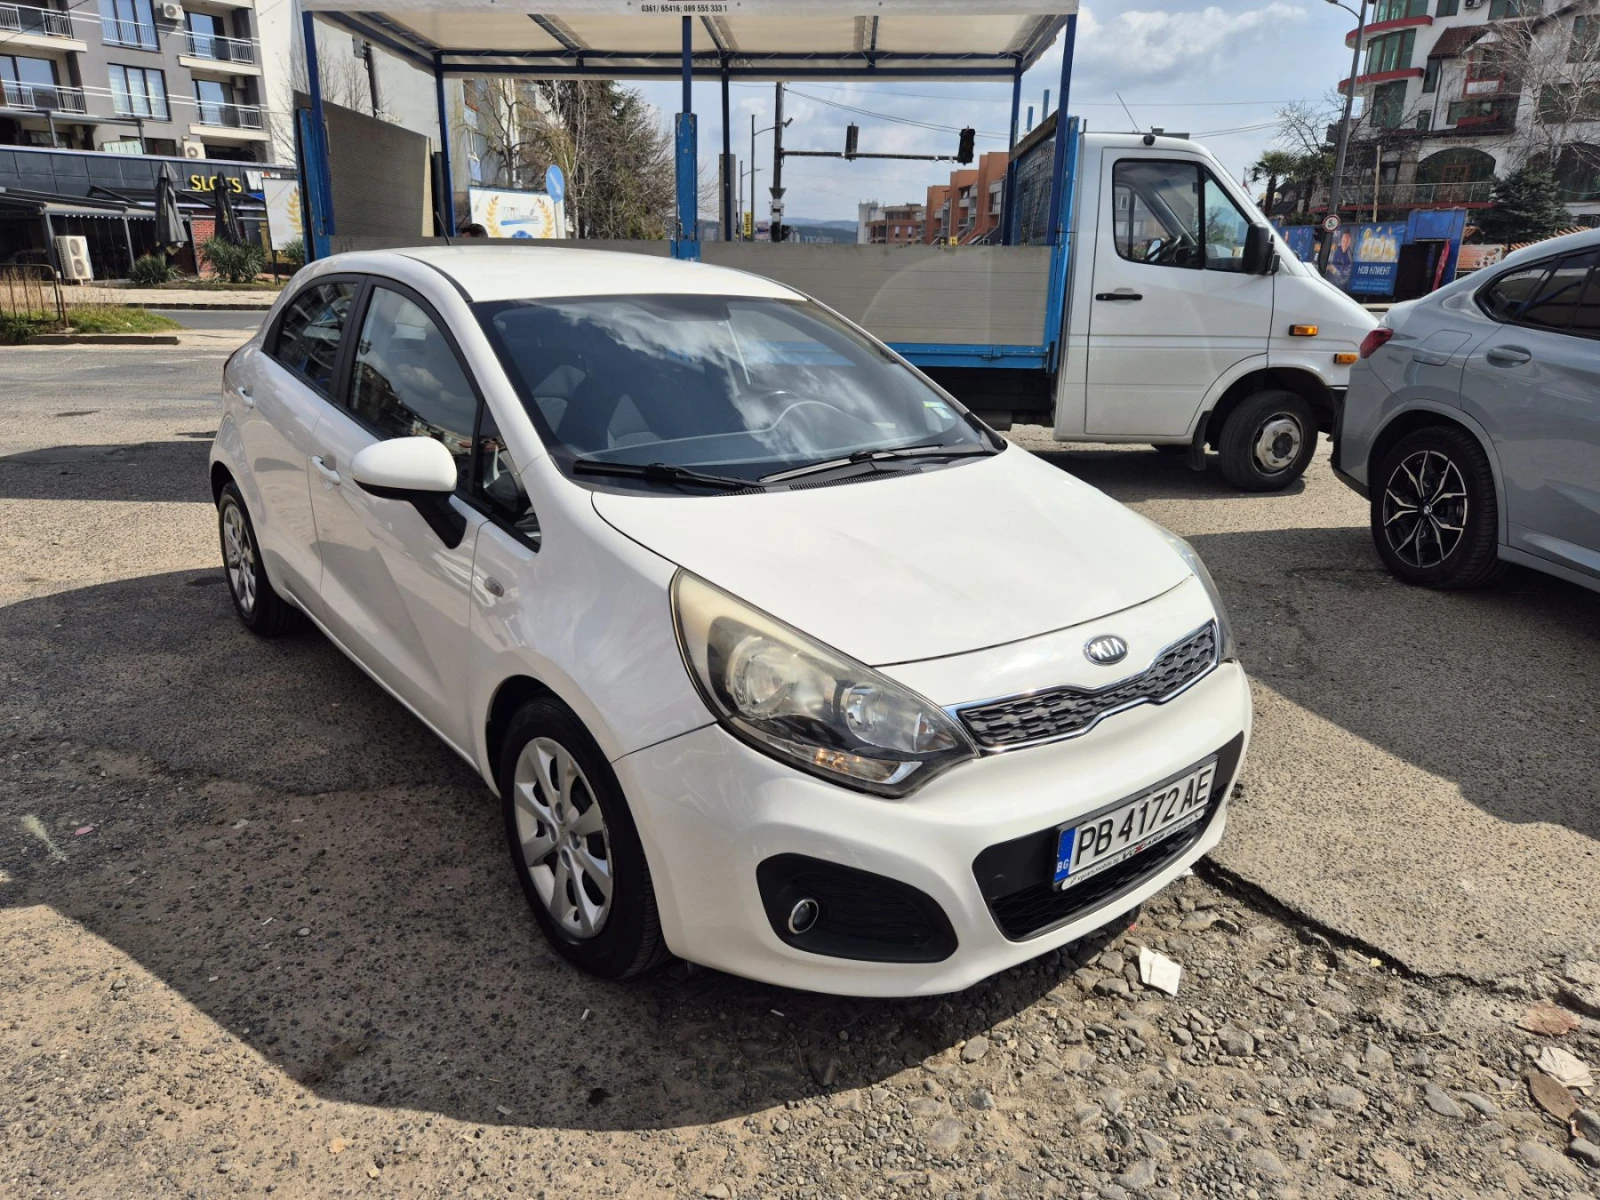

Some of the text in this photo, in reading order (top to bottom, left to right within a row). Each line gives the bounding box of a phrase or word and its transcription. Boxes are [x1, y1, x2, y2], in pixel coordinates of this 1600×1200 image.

[683, 4, 696, 13] 089
[697, 4, 709, 13] 555
[710, 4, 722, 13] 333
[190, 174, 242, 193] SLOS
[1075, 818, 1114, 866] PB
[1118, 786, 1180, 843] 4172
[1180, 768, 1212, 814] AE
[1056, 859, 1070, 873] BG
